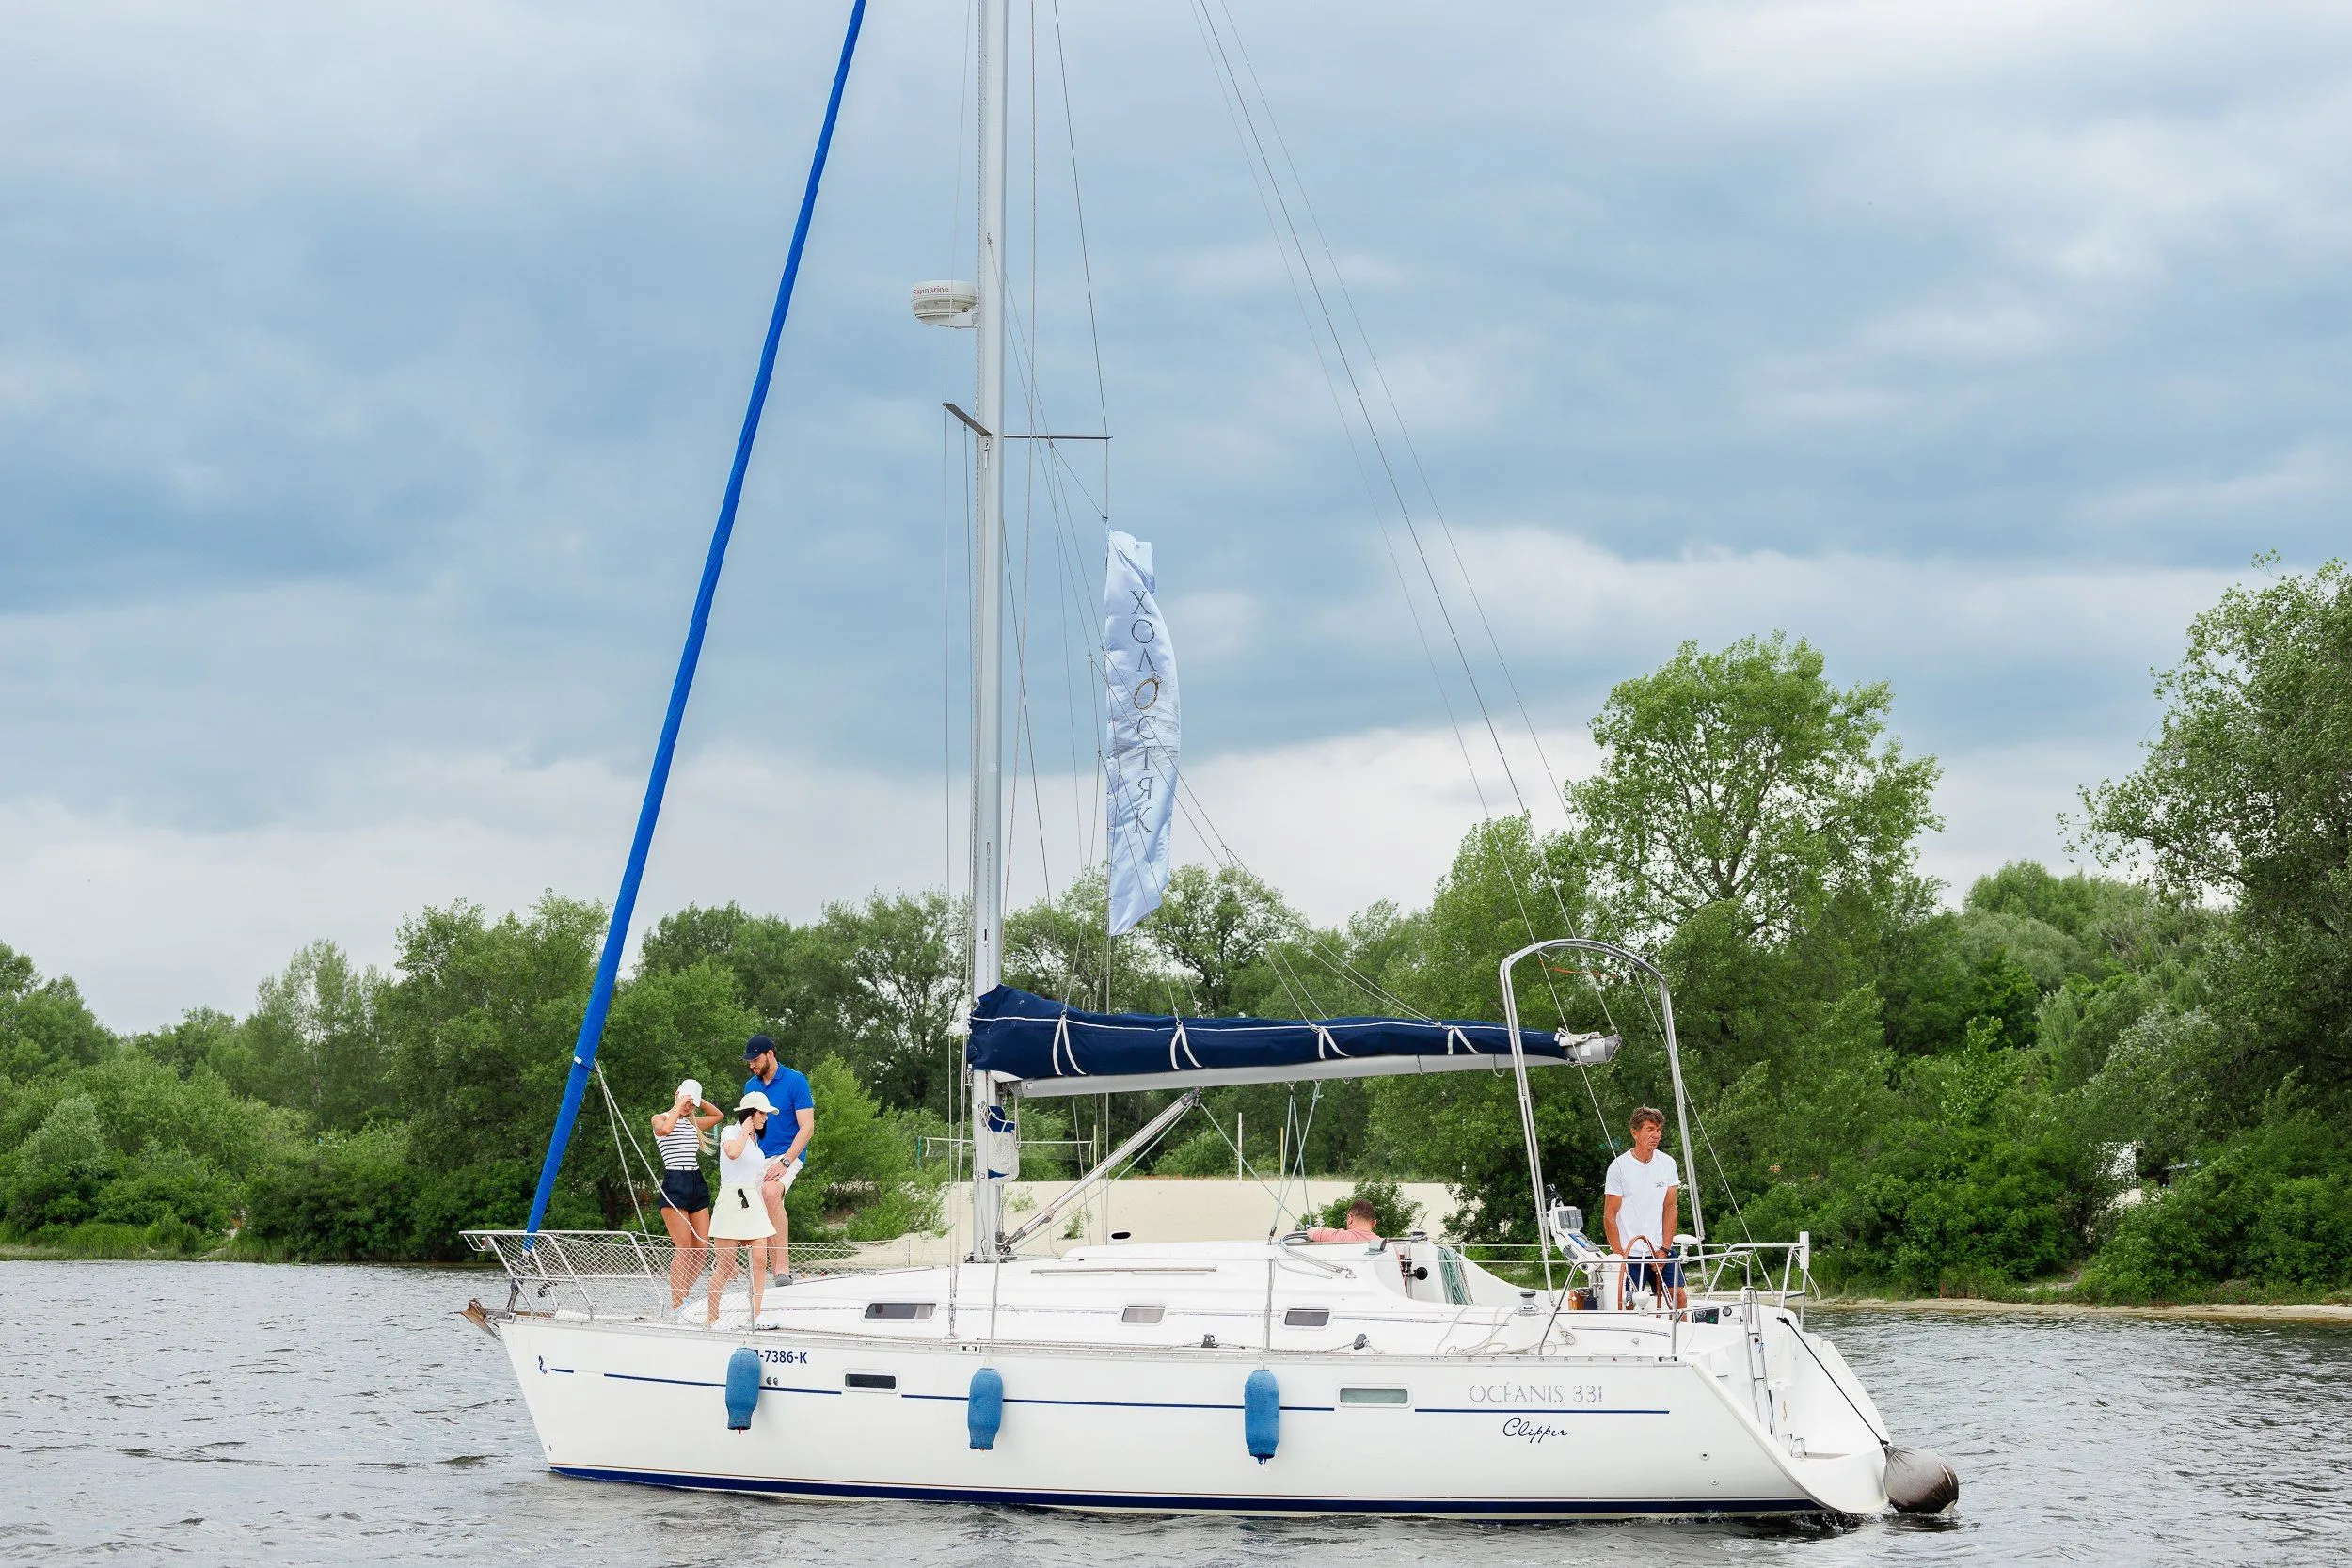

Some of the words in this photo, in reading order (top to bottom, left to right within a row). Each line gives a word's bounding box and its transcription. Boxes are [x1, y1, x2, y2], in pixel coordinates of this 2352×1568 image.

[1130, 590, 1163, 834] ХОЛОСТЯК
[1469, 1382, 1564, 1402] OCÉANIS
[1573, 1385, 1603, 1402] 331
[1502, 1418, 1568, 1444] Clipper
